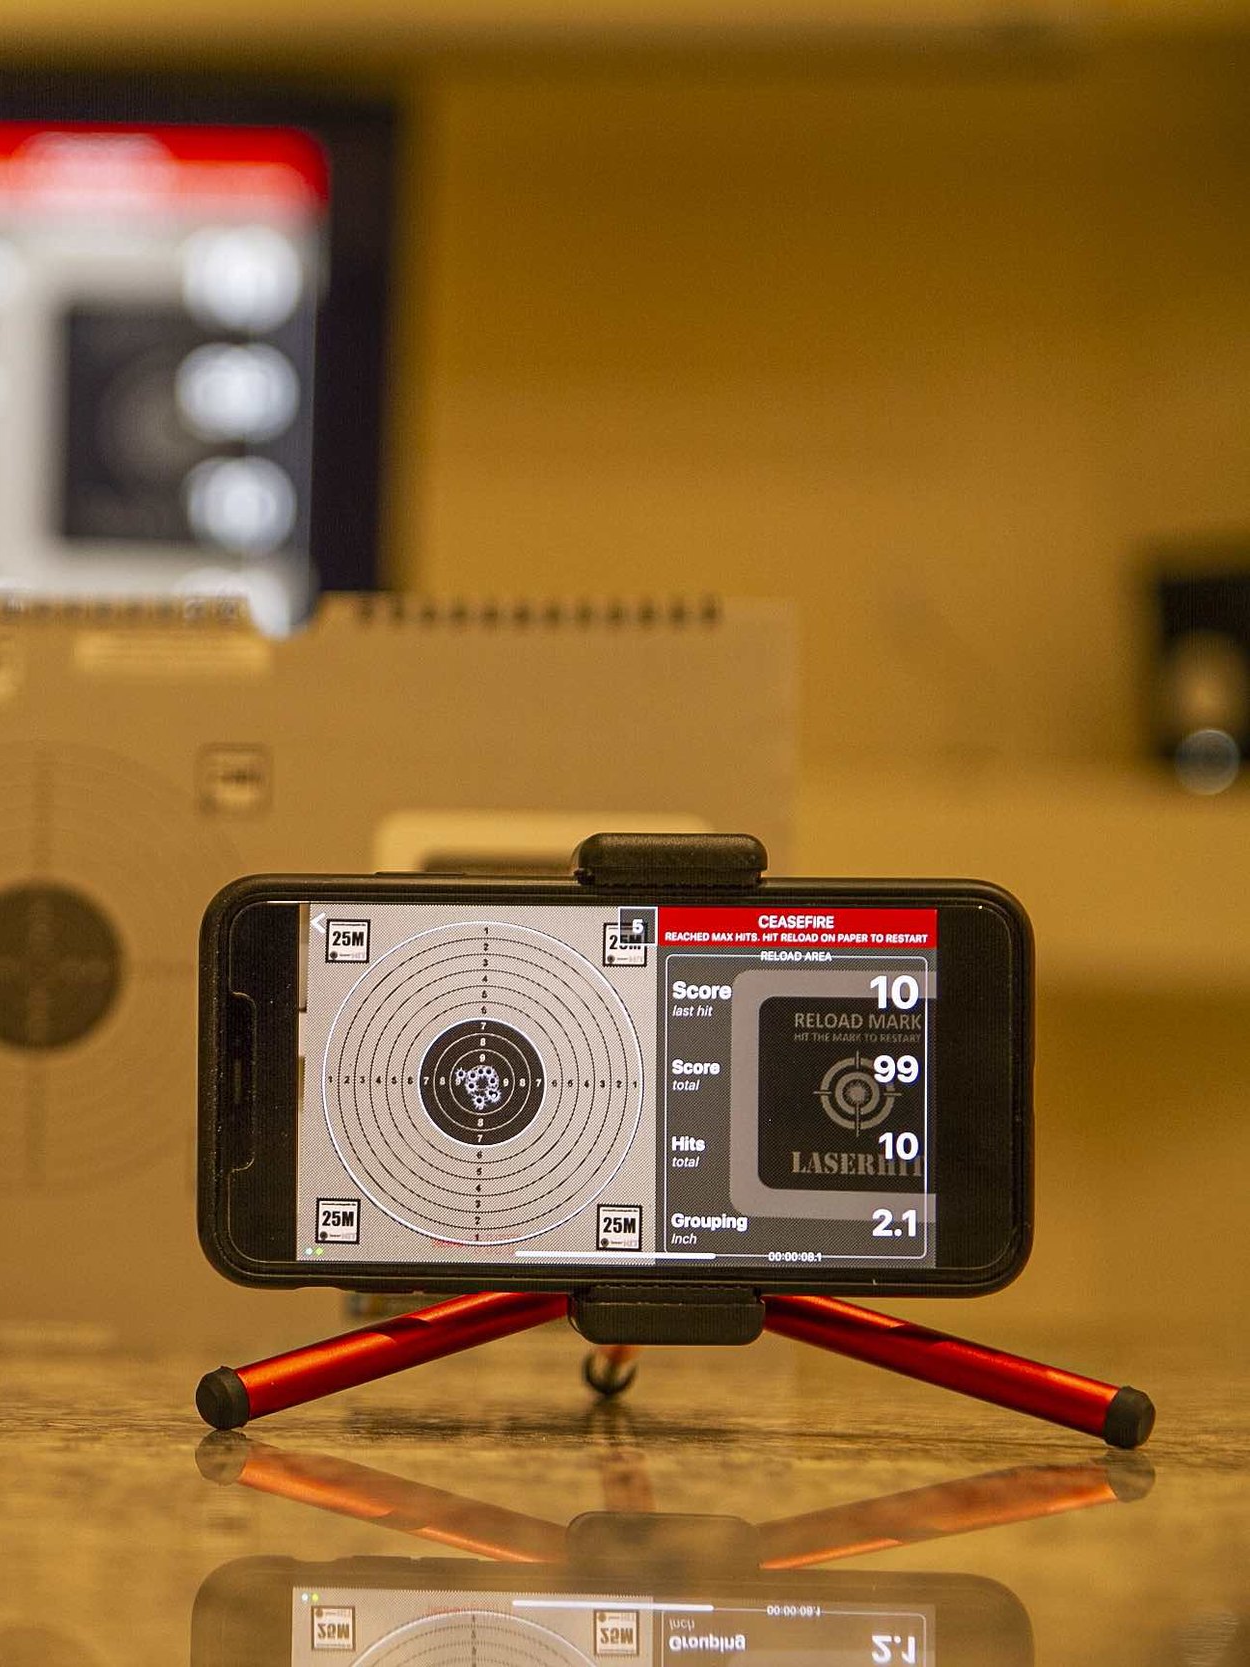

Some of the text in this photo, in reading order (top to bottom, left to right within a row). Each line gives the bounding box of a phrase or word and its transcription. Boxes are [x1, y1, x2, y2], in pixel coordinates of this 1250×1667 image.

[632, 918, 644, 935] 5
[758, 915, 834, 930] CEASEFIRE
[332, 930, 365, 947] 25M
[664, 931, 928, 944] REACHED MAX HITS. HIT RELOAD ON PAPER TO RESTART
[760, 950, 833, 962] RELOAD AREA
[672, 980, 732, 1000] Score
[869, 974, 920, 1010] 10
[672, 1004, 713, 1017] last hit
[794, 1012, 922, 1030] RELOAD MARK
[810, 1032, 830, 1042] THE
[672, 1059, 721, 1075] Score
[873, 1054, 919, 1084] 99
[672, 1080, 700, 1091] total
[671, 1136, 706, 1152] Hits
[878, 1132, 919, 1160] 10
[672, 1155, 700, 1168] total
[322, 1210, 355, 1227] 25M
[602, 1216, 637, 1234] 25M
[671, 1213, 749, 1232] Grouping
[871, 1209, 918, 1238] 2.1
